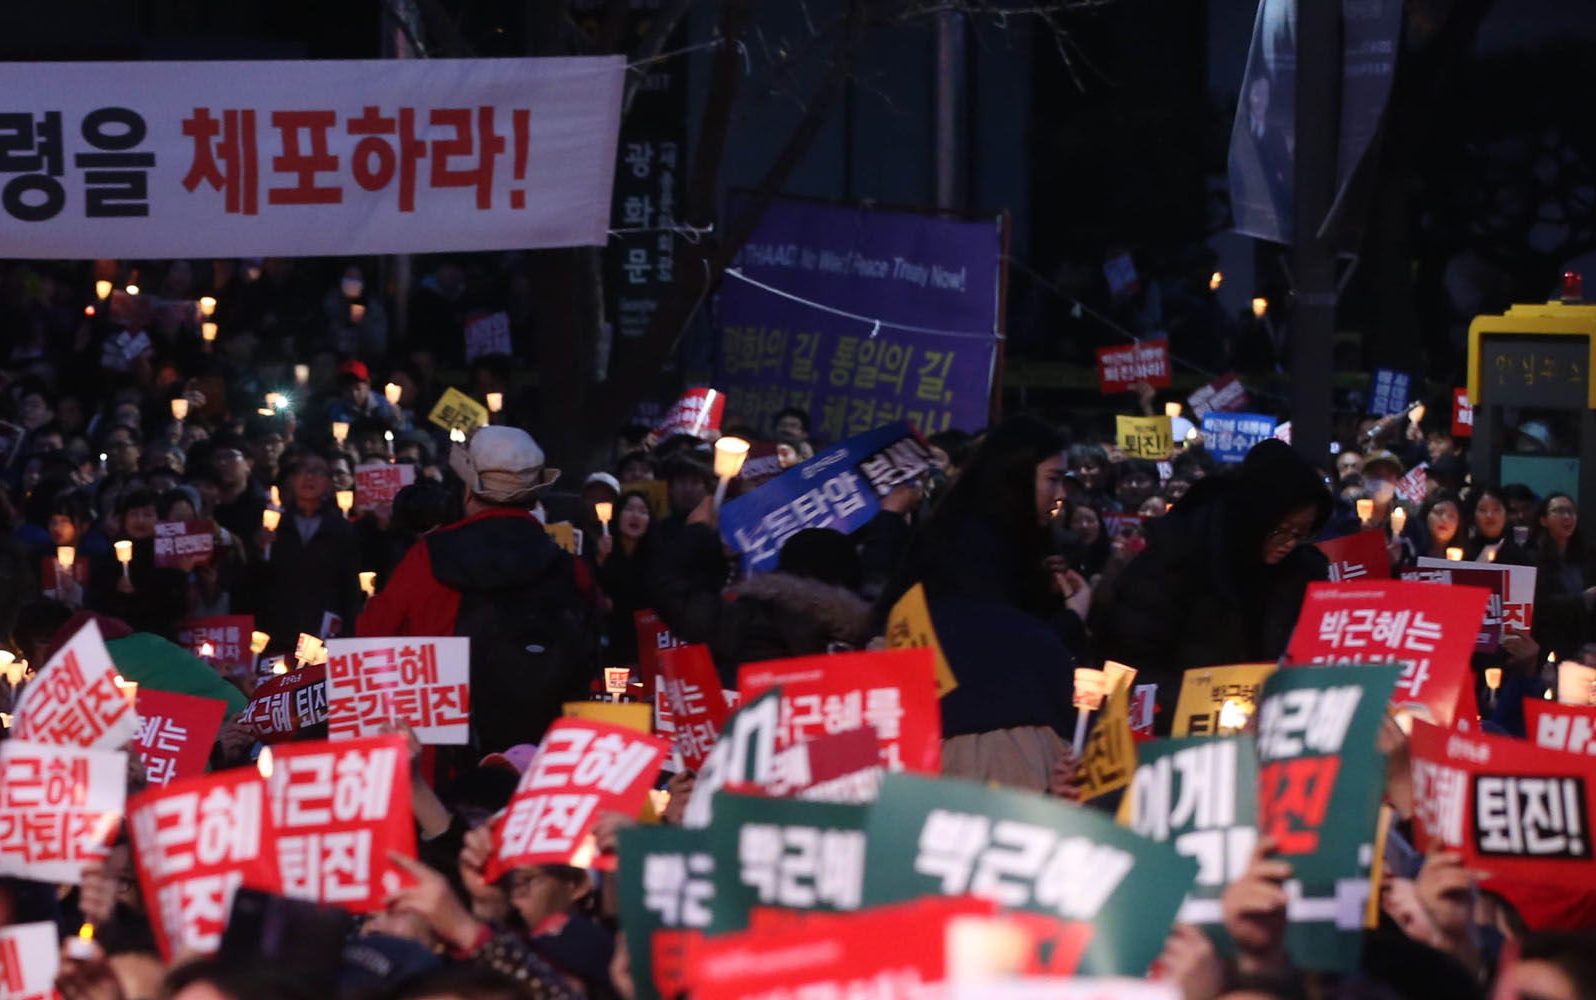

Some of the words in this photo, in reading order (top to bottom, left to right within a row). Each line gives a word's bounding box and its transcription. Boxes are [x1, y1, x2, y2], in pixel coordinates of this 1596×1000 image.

[181, 105, 531, 216] 체포하라!
[828, 335, 913, 396] 통일의
[915, 349, 956, 404] 길,
[1124, 432, 1168, 455] 퇴진!
[1318, 607, 1444, 653] 박근혜는
[329, 643, 438, 695] 박근혜
[328, 683, 471, 738] 즉각퇴진
[514, 727, 658, 797] 근혜
[1130, 742, 1241, 843] 이게
[497, 794, 602, 861] 퇴진
[1476, 777, 1583, 858] 퇴진!
[276, 830, 372, 903] 퇴진
[642, 851, 716, 927] 박근
[738, 822, 867, 910] 박근혜
[915, 807, 1135, 919] 박근혜
